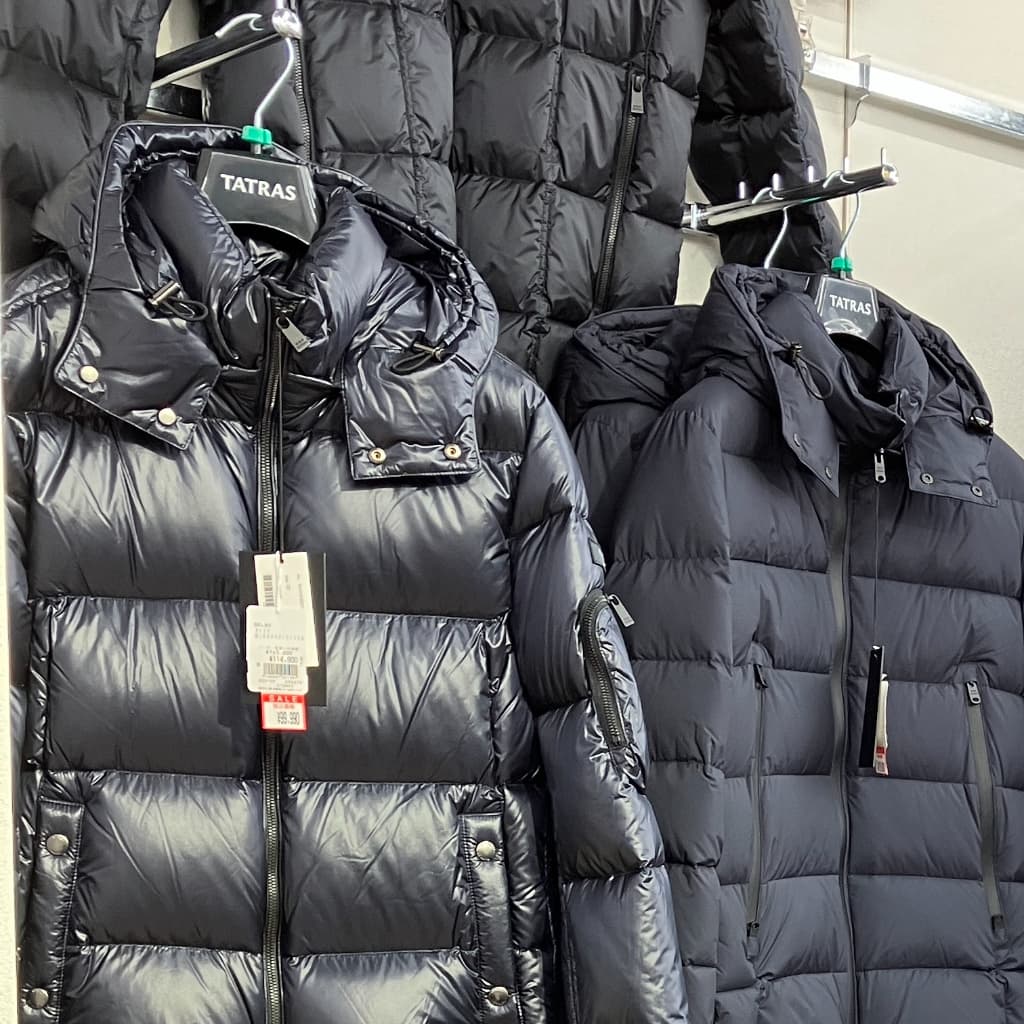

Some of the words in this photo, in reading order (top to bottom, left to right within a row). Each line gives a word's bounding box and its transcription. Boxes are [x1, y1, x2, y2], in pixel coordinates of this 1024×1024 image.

[220, 173, 297, 201] TATRAS
[829, 294, 872, 316] TATRAS
[269, 694, 298, 703] SALE
